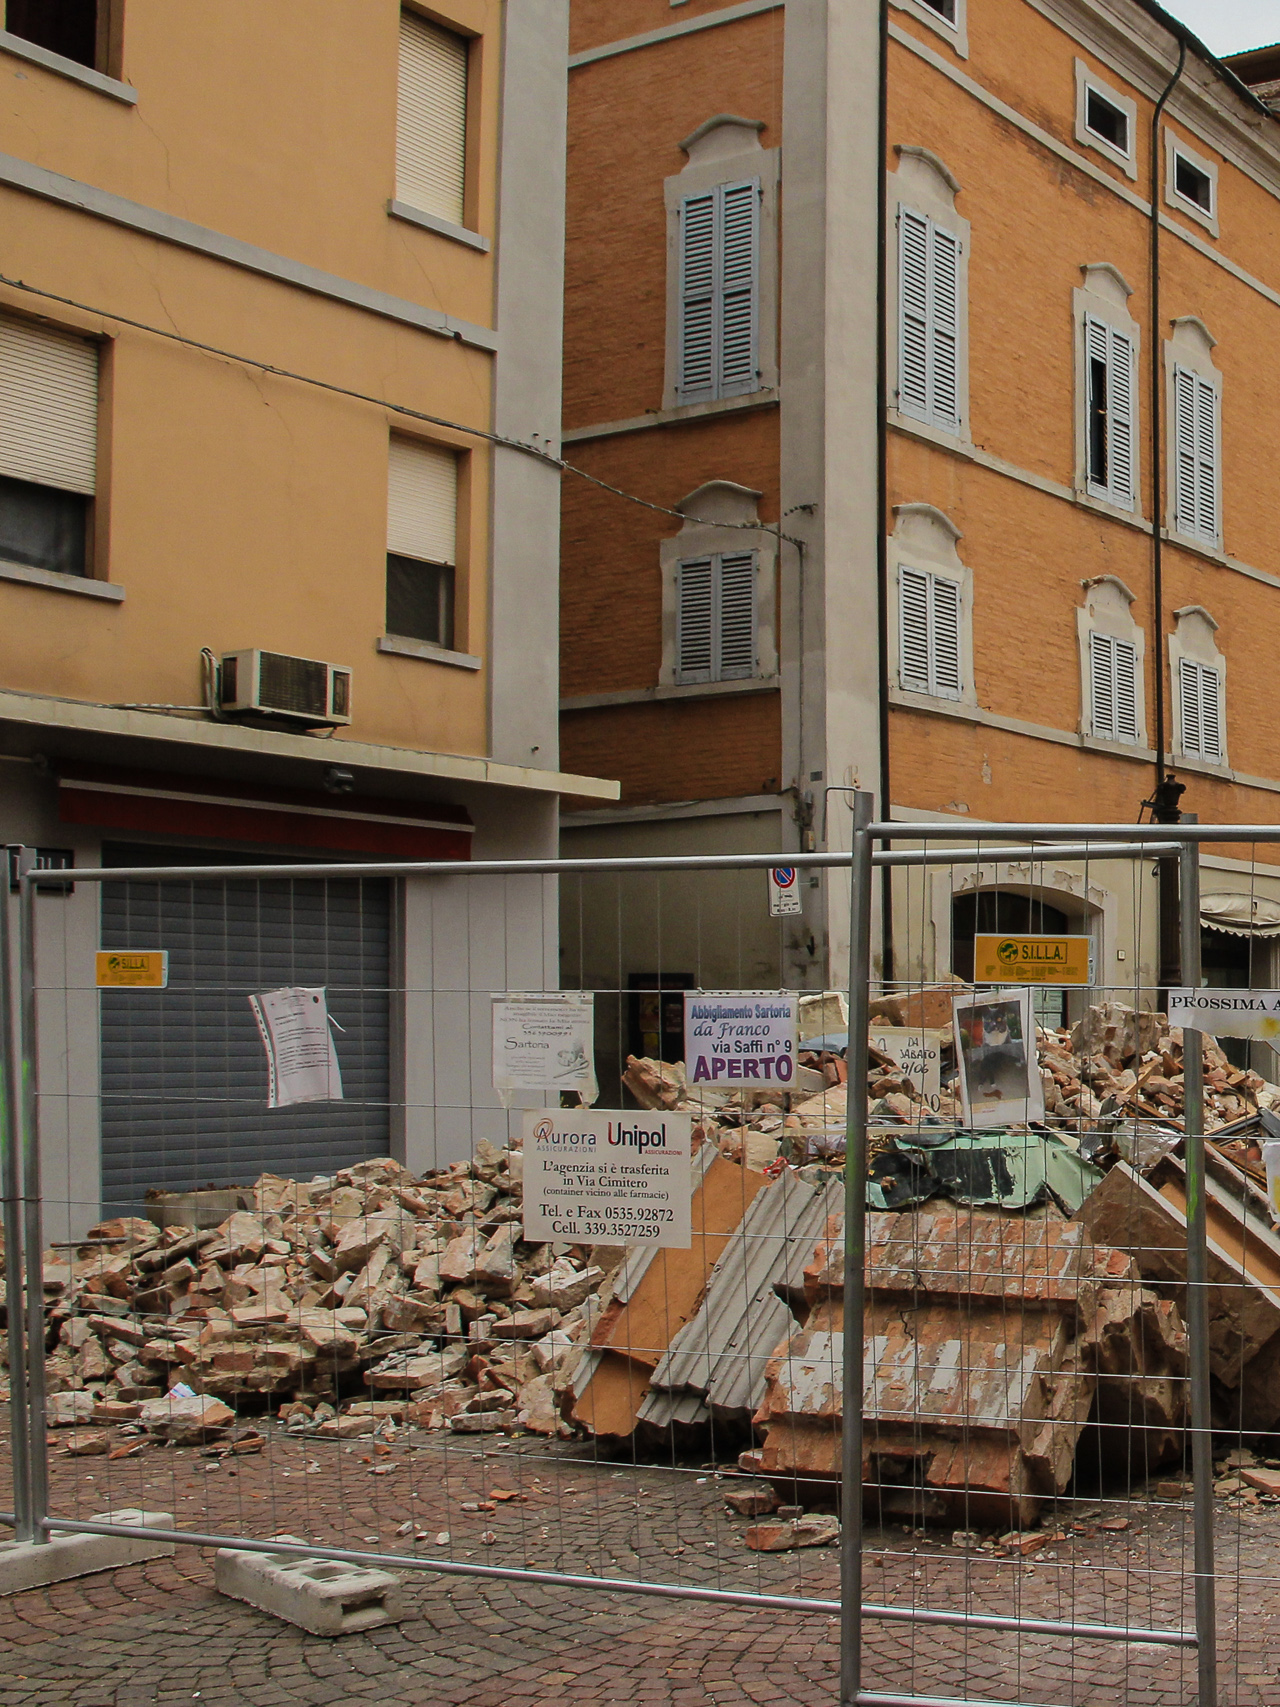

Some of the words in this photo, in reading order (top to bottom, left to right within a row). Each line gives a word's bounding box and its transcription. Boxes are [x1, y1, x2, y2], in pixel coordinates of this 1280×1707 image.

[1022, 944, 1064, 960] S.I.L.L.A.
[1170, 996, 1267, 1011] PROSSIMA
[691, 1004, 753, 1022] Abbigliamento
[754, 1003, 791, 1019] Sartoria
[693, 1020, 714, 1036] da
[717, 1022, 771, 1039] Franco
[504, 1037, 550, 1050] Sartoria
[711, 1040, 731, 1053] via
[734, 1039, 763, 1053] Saffi
[767, 1039, 780, 1053] n°
[784, 1039, 792, 1053] 9
[692, 1054, 793, 1083] APERTO
[534, 1122, 597, 1145] Aurora
[608, 1121, 666, 1155] Unipol
[536, 1145, 597, 1153] ASSICURAZIONI
[542, 1160, 595, 1175] L'agenzia
[598, 1162, 608, 1174] si
[610, 1163, 617, 1174] è
[620, 1164, 669, 1175] trasferita
[563, 1175, 574, 1186] in
[576, 1175, 595, 1187] Via
[598, 1176, 648, 1188] Cimitero
[543, 1186, 583, 1197] (container
[585, 1188, 611, 1198] vicino
[613, 1189, 628, 1198] alle
[629, 1189, 669, 1201] farmacie)
[539, 1203, 562, 1217] Tel.
[566, 1209, 573, 1218] e
[577, 1205, 602, 1219] Fax
[605, 1206, 674, 1222] 0535.92872
[552, 1220, 581, 1234] Cell.
[584, 1222, 660, 1238] 339.3527259
